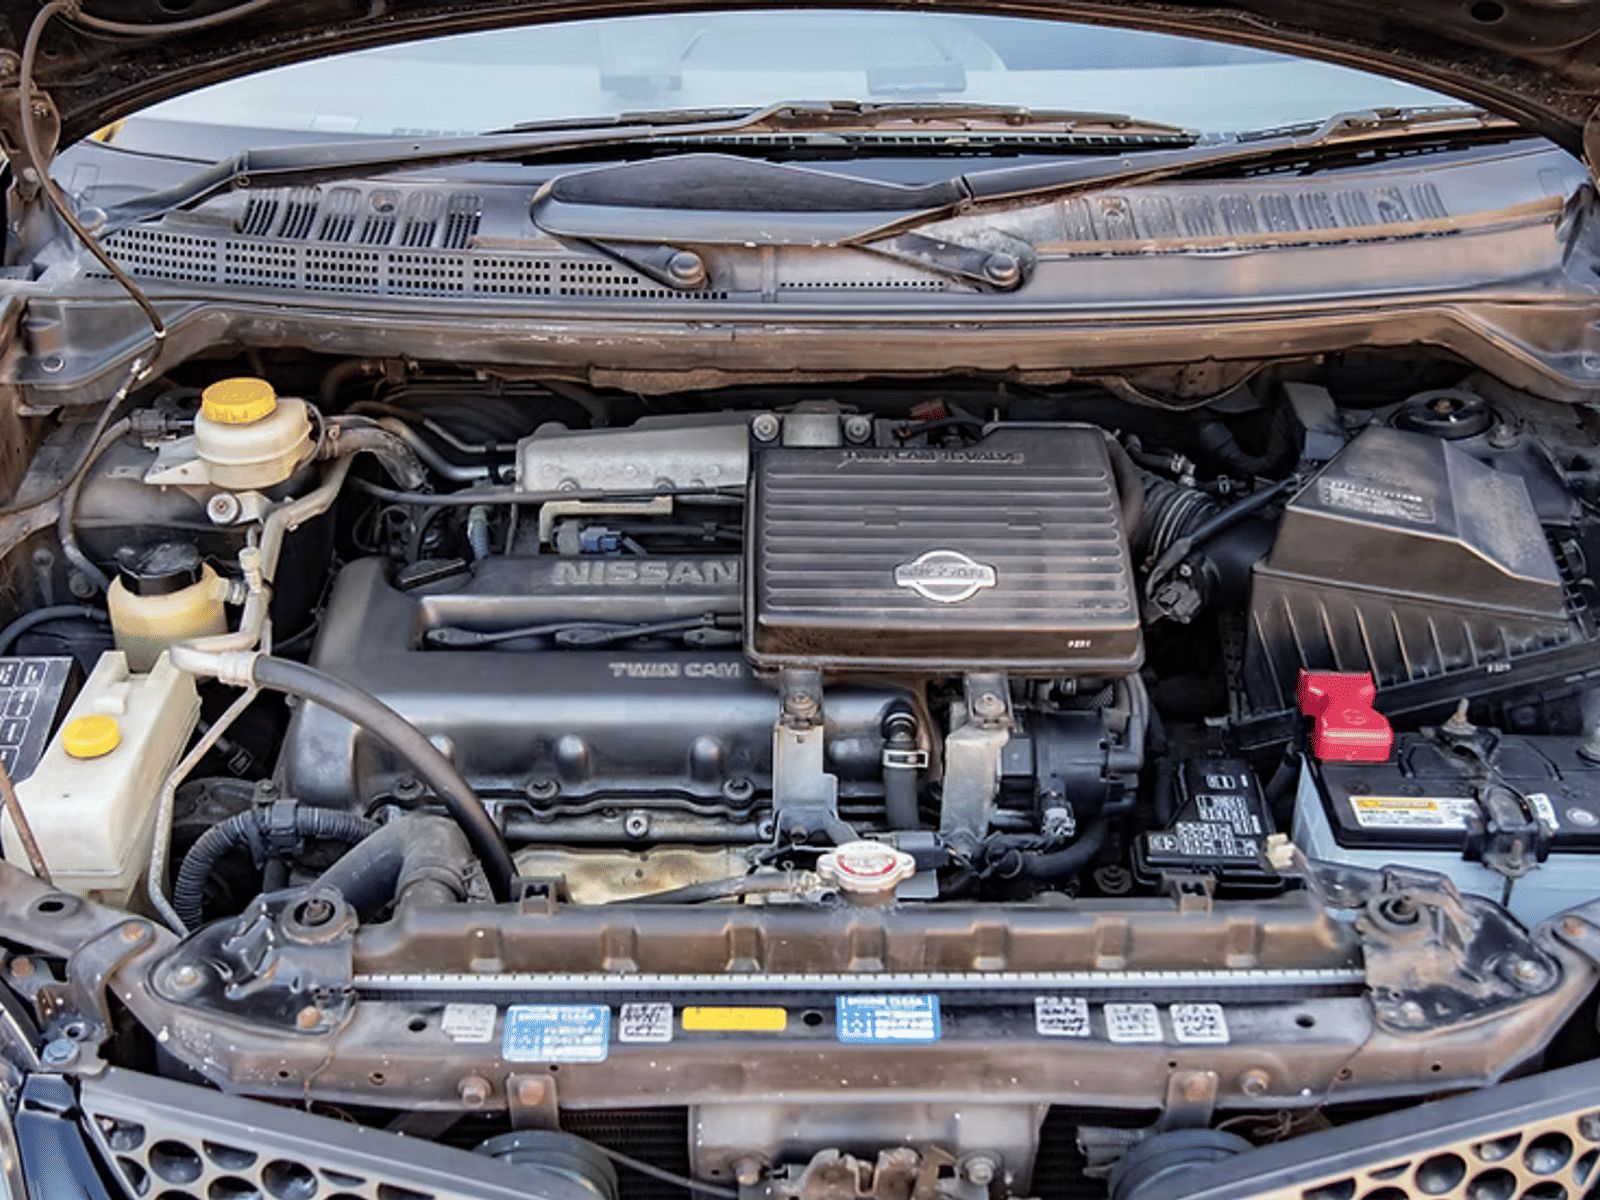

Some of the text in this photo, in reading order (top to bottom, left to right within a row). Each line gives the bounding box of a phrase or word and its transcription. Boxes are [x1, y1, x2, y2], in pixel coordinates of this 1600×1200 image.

[551, 560, 740, 586] NISSAN
[608, 661, 681, 678] TWIN
[684, 661, 742, 678] CAM
